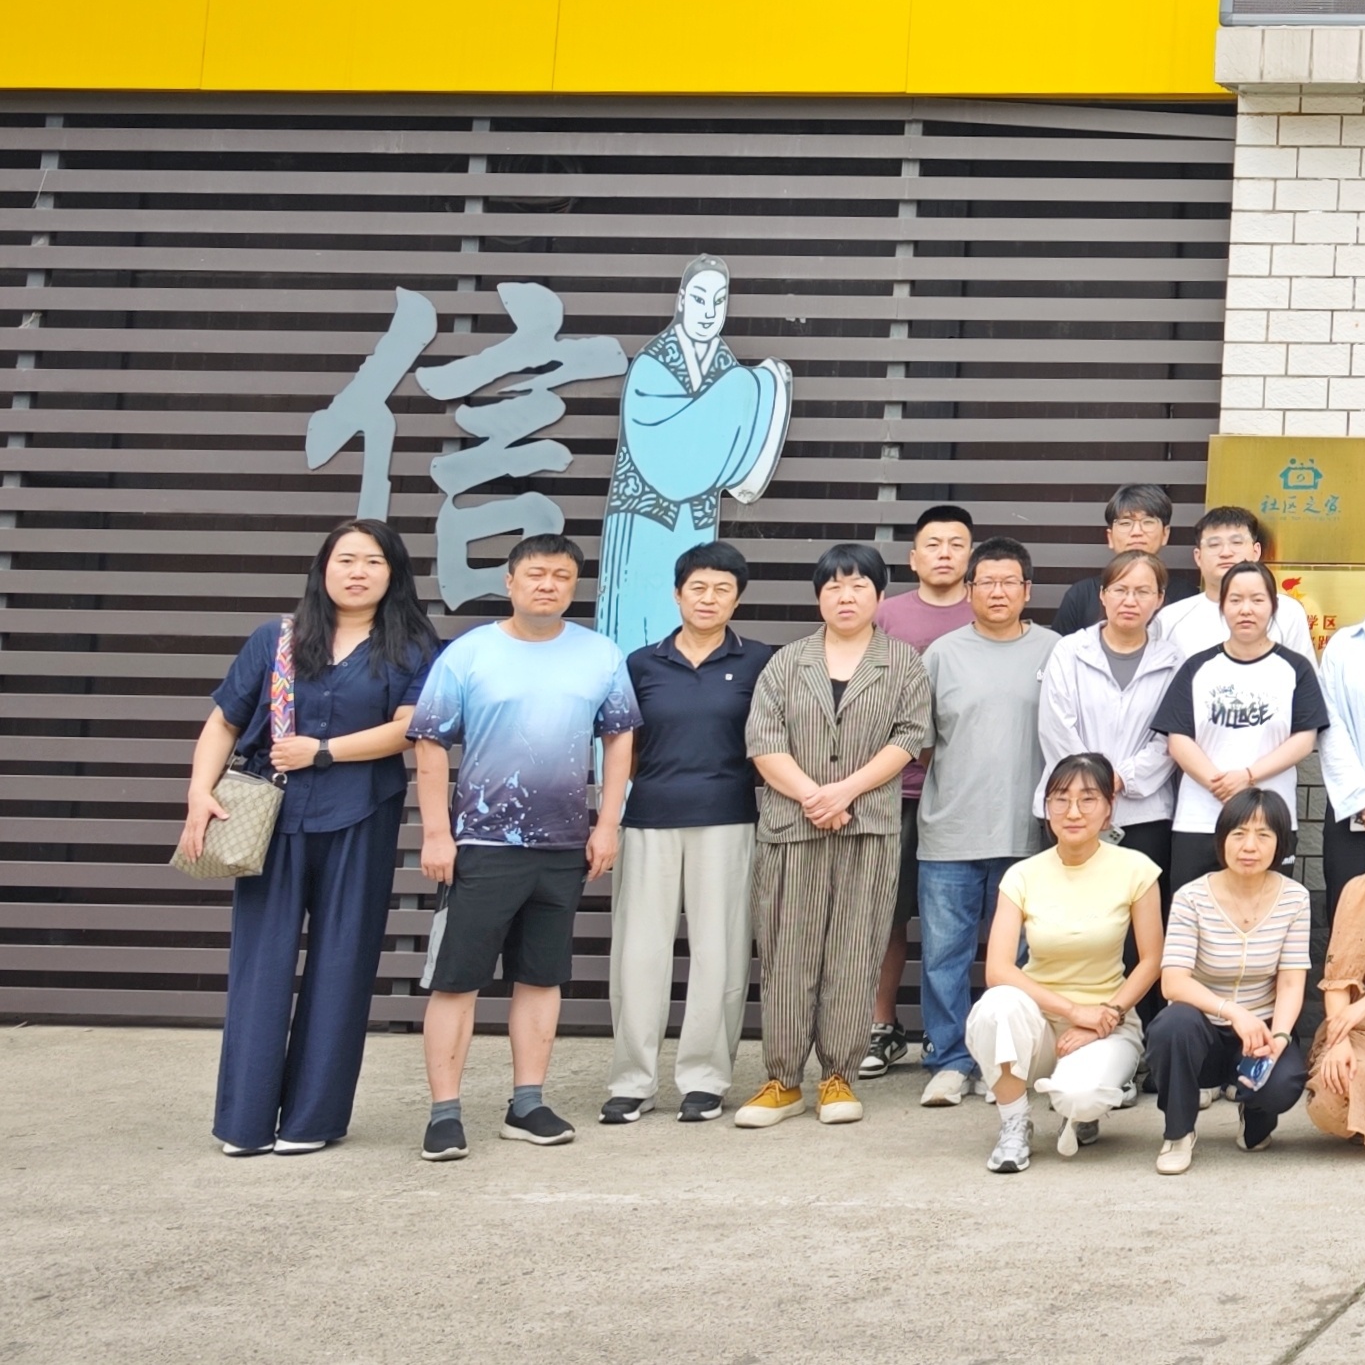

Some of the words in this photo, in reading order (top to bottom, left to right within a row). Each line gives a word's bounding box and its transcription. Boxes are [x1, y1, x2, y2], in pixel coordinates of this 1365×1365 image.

[305, 282, 628, 611] 信
[1261, 495, 1341, 515] 社区之家
[1208, 700, 1274, 729] VILLAGE
